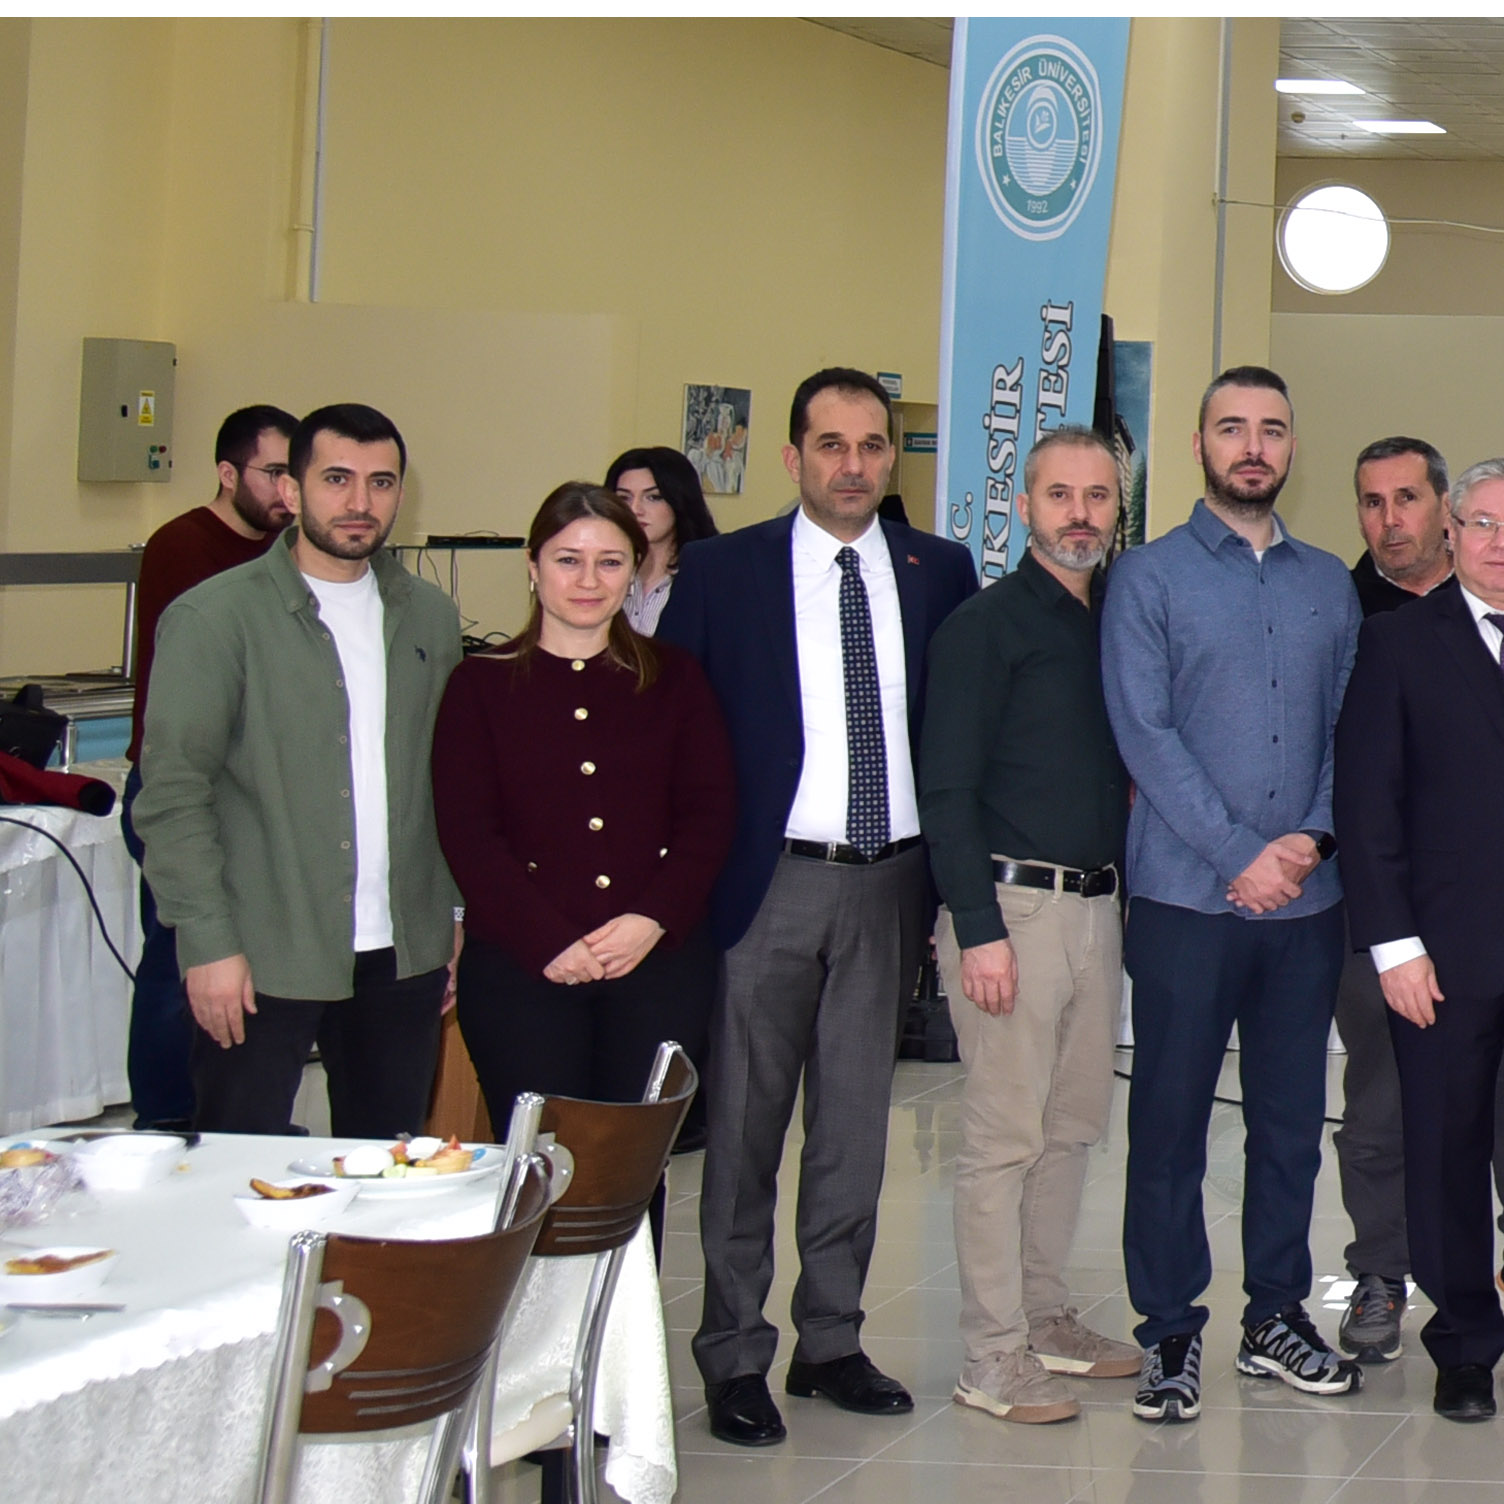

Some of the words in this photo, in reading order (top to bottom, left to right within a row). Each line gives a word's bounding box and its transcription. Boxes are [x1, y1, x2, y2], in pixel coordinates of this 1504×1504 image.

[993, 66, 1032, 158] BALIKESİR
[1038, 58, 1090, 164] ÜNİVERSİTESİ
[1026, 199, 1048, 214] 1992
